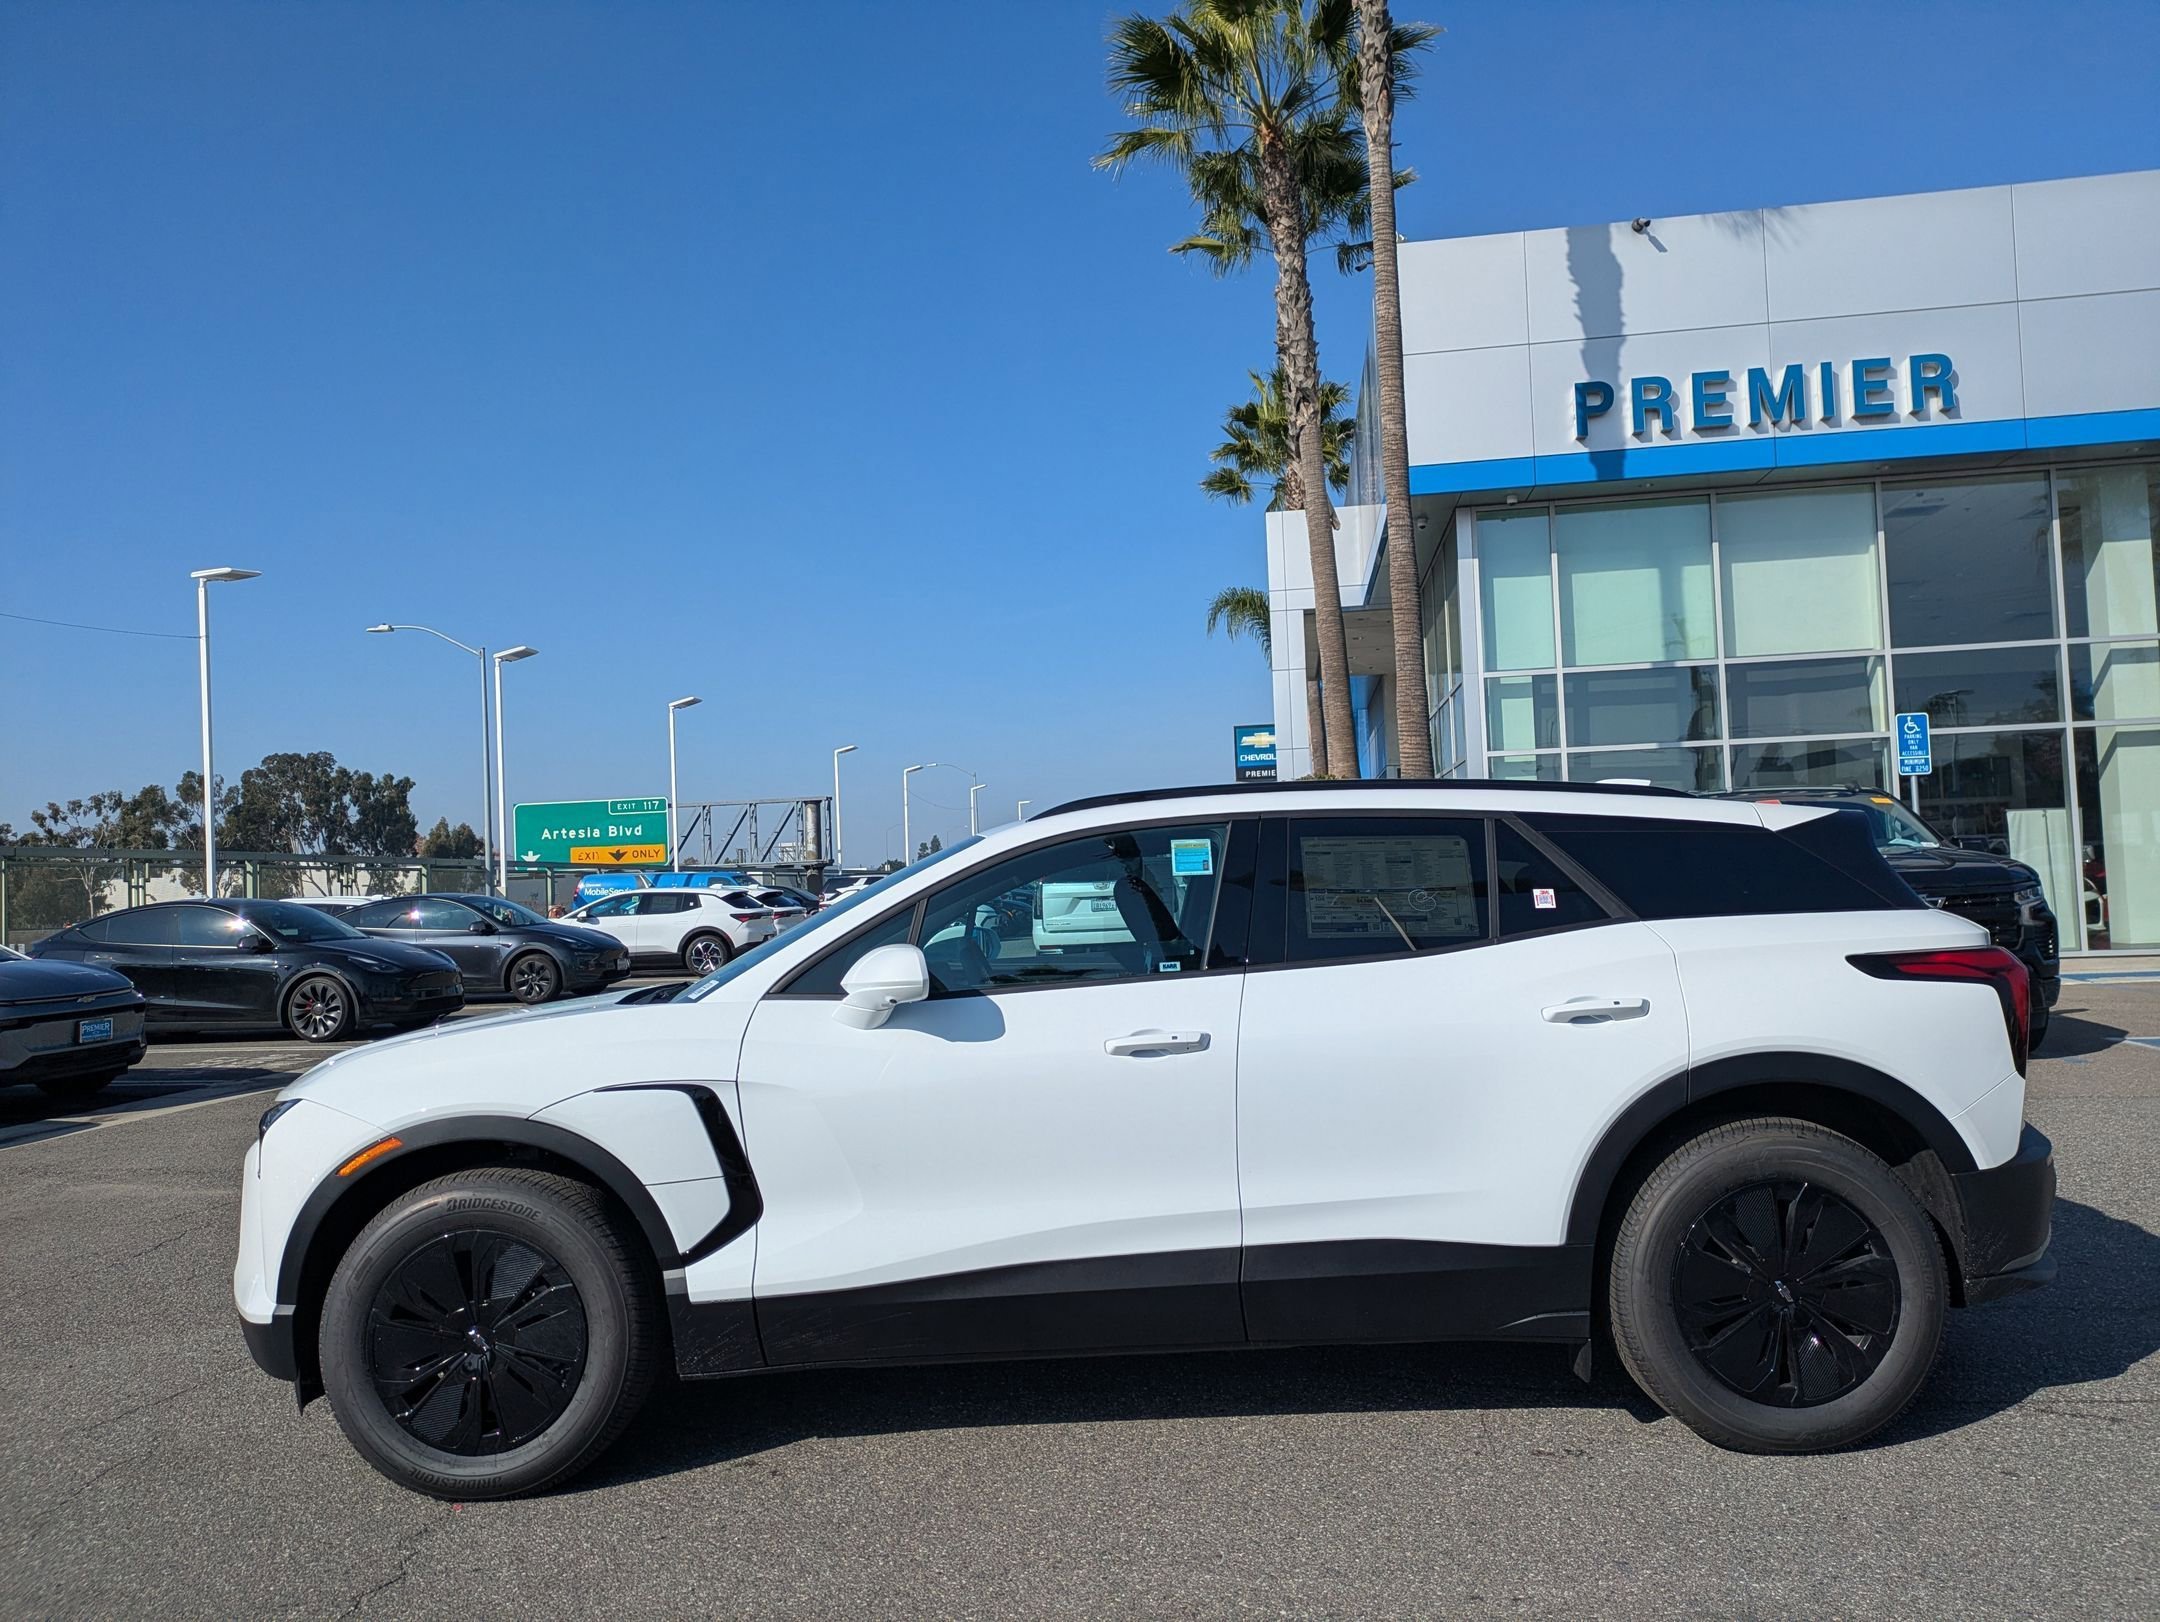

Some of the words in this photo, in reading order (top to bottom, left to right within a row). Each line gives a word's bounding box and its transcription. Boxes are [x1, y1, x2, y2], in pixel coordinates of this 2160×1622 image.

[1574, 353, 1957, 441] PREMIER
[643, 801, 659, 810] 117
[541, 828, 600, 840] Artesia
[608, 824, 642, 837] Blvd
[632, 850, 660, 859] ONLY
[82, 1022, 110, 1032] PREMIER
[446, 1198, 541, 1220] BRIDGESTONE
